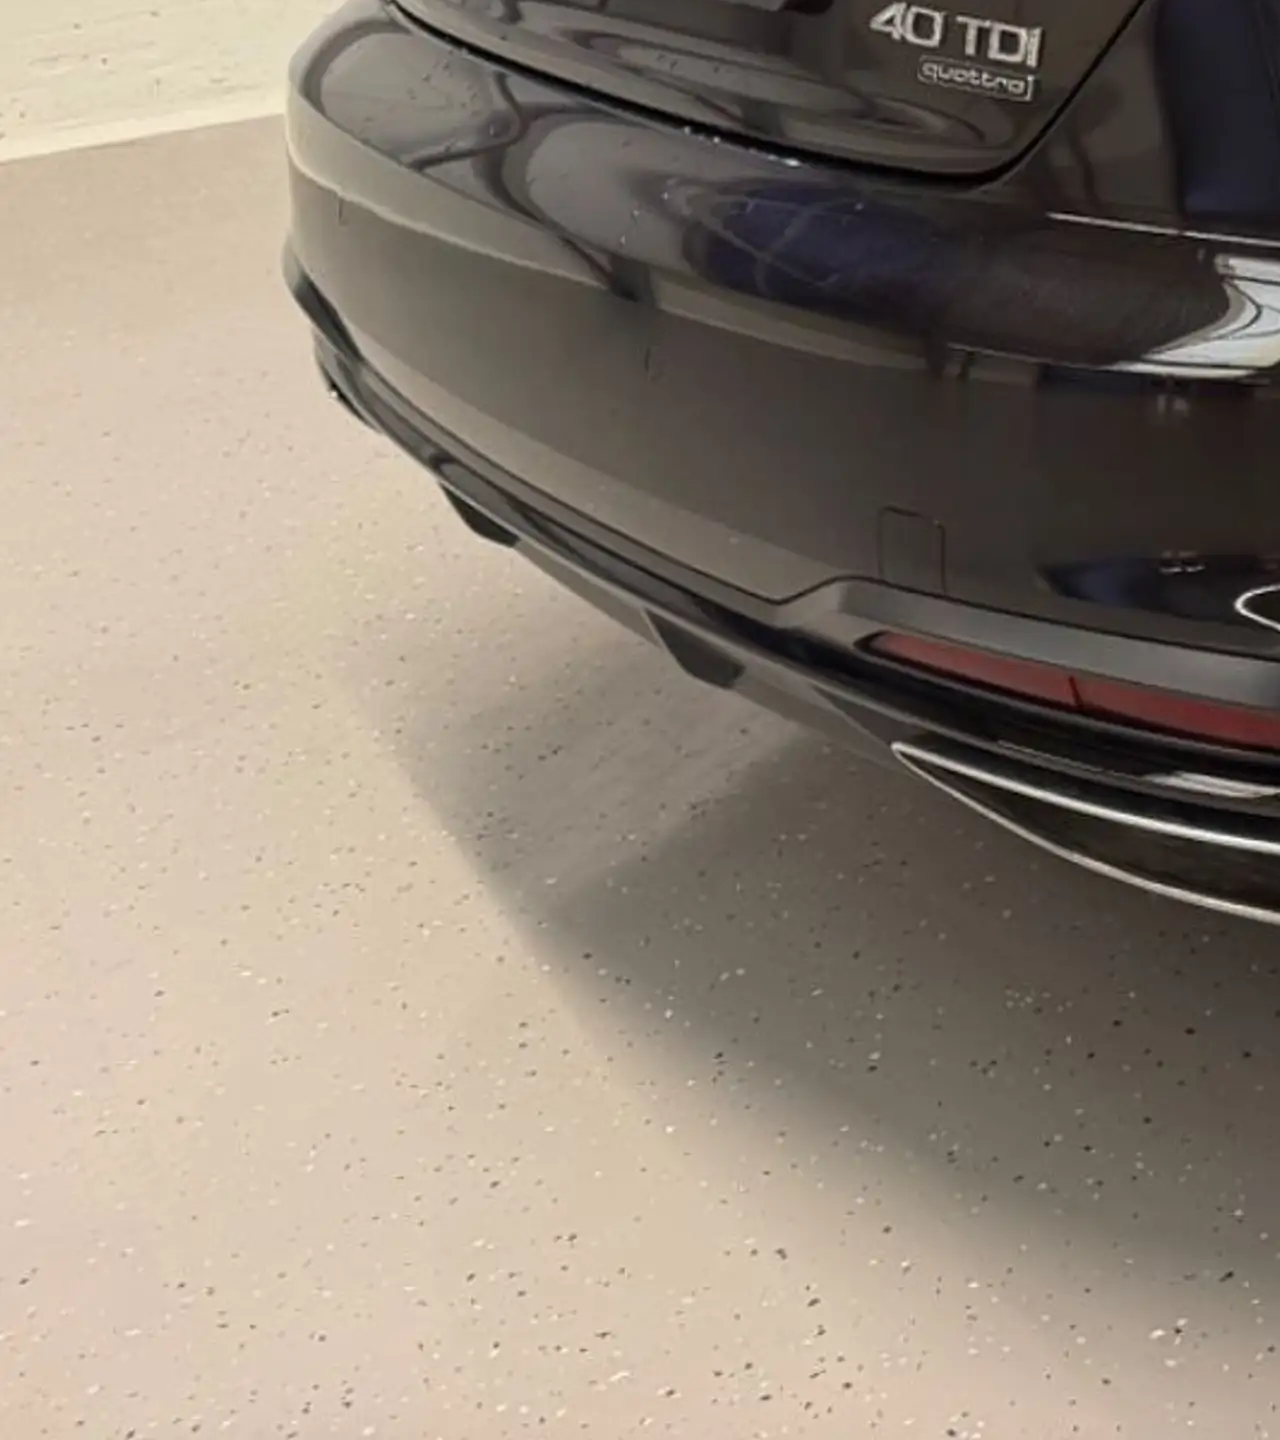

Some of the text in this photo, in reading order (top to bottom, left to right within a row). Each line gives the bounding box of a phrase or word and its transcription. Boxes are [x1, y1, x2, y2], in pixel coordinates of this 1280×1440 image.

[868, 1, 1043, 68] 40 TDI
[920, 60, 1027, 95] quattro
